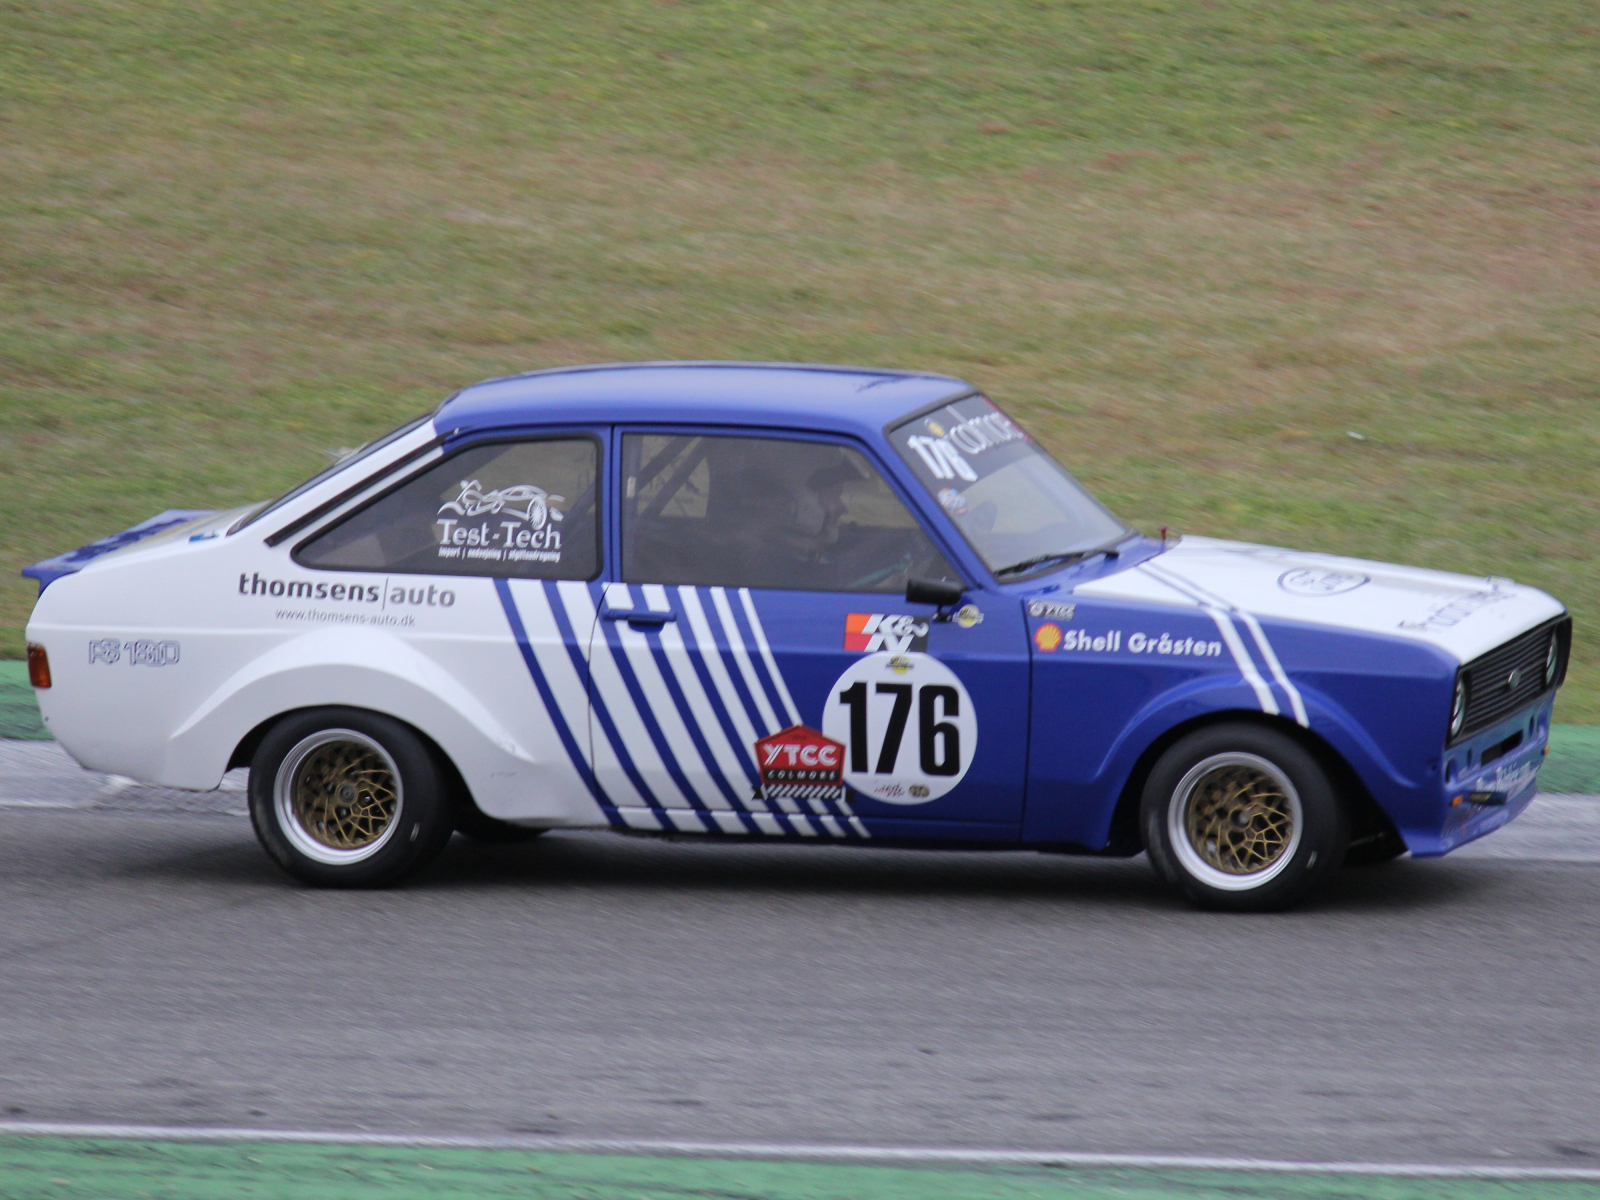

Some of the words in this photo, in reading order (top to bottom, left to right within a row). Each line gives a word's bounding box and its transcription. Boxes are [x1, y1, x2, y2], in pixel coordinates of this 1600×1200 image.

[907, 435, 978, 482] 176
[436, 519, 562, 550] Test-Tech
[275, 608, 416, 627] www.thomsens-auto.dk
[89, 638, 121, 665] RS
[1063, 629, 1122, 653] Shell
[1127, 632, 1223, 657] Gråsten
[839, 680, 961, 777] 176
[763, 743, 838, 767] YTCC
